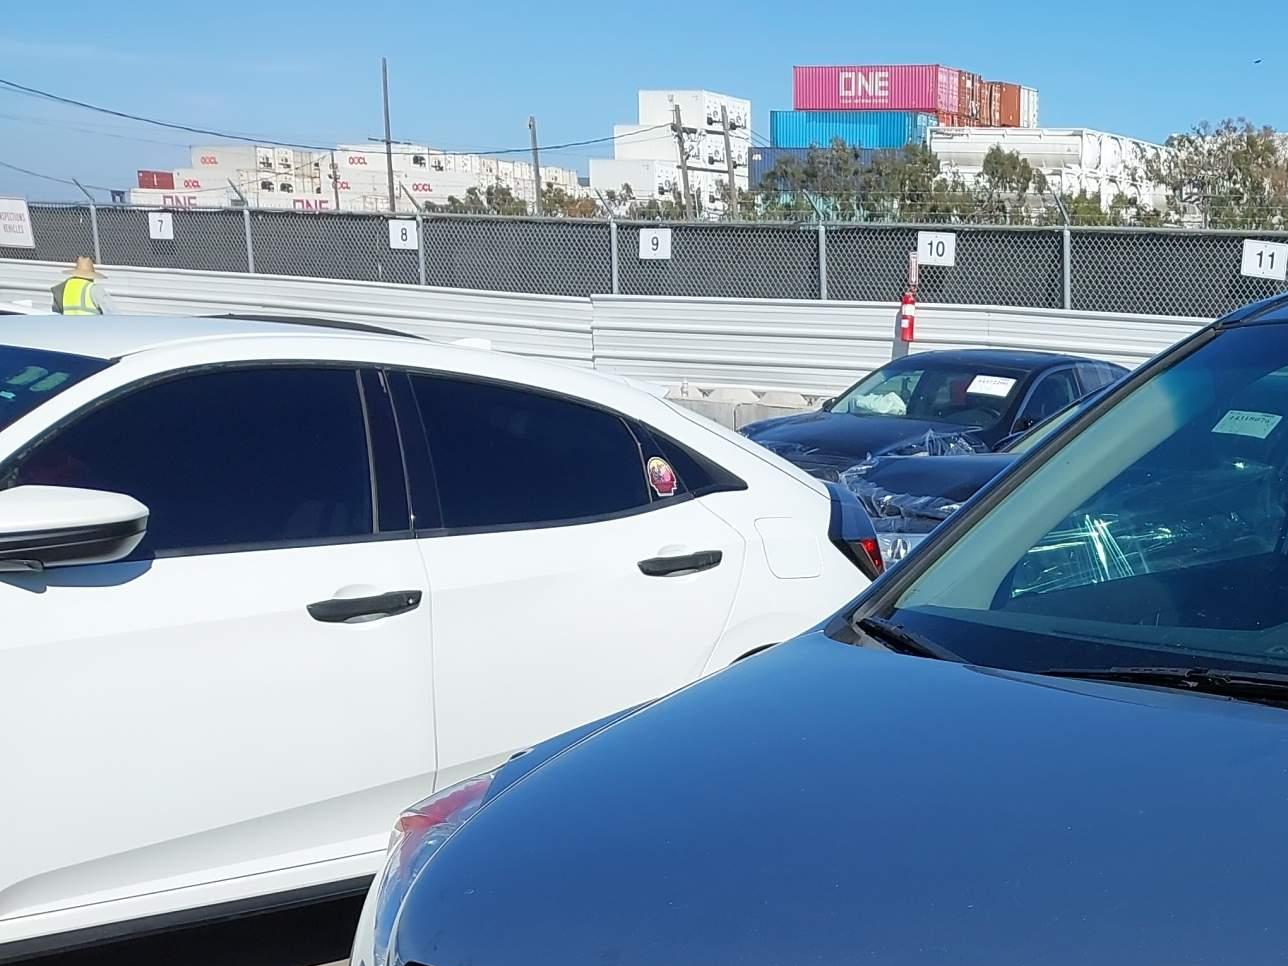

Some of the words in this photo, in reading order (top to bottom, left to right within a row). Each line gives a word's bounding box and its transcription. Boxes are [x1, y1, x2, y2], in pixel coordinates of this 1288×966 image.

[839, 71, 889, 97] ONE
[157, 219, 164, 233] 7
[400, 227, 408, 242] 8
[651, 236, 659, 251] 9
[927, 240, 946, 258] 10
[1256, 250, 1275, 270] 11
